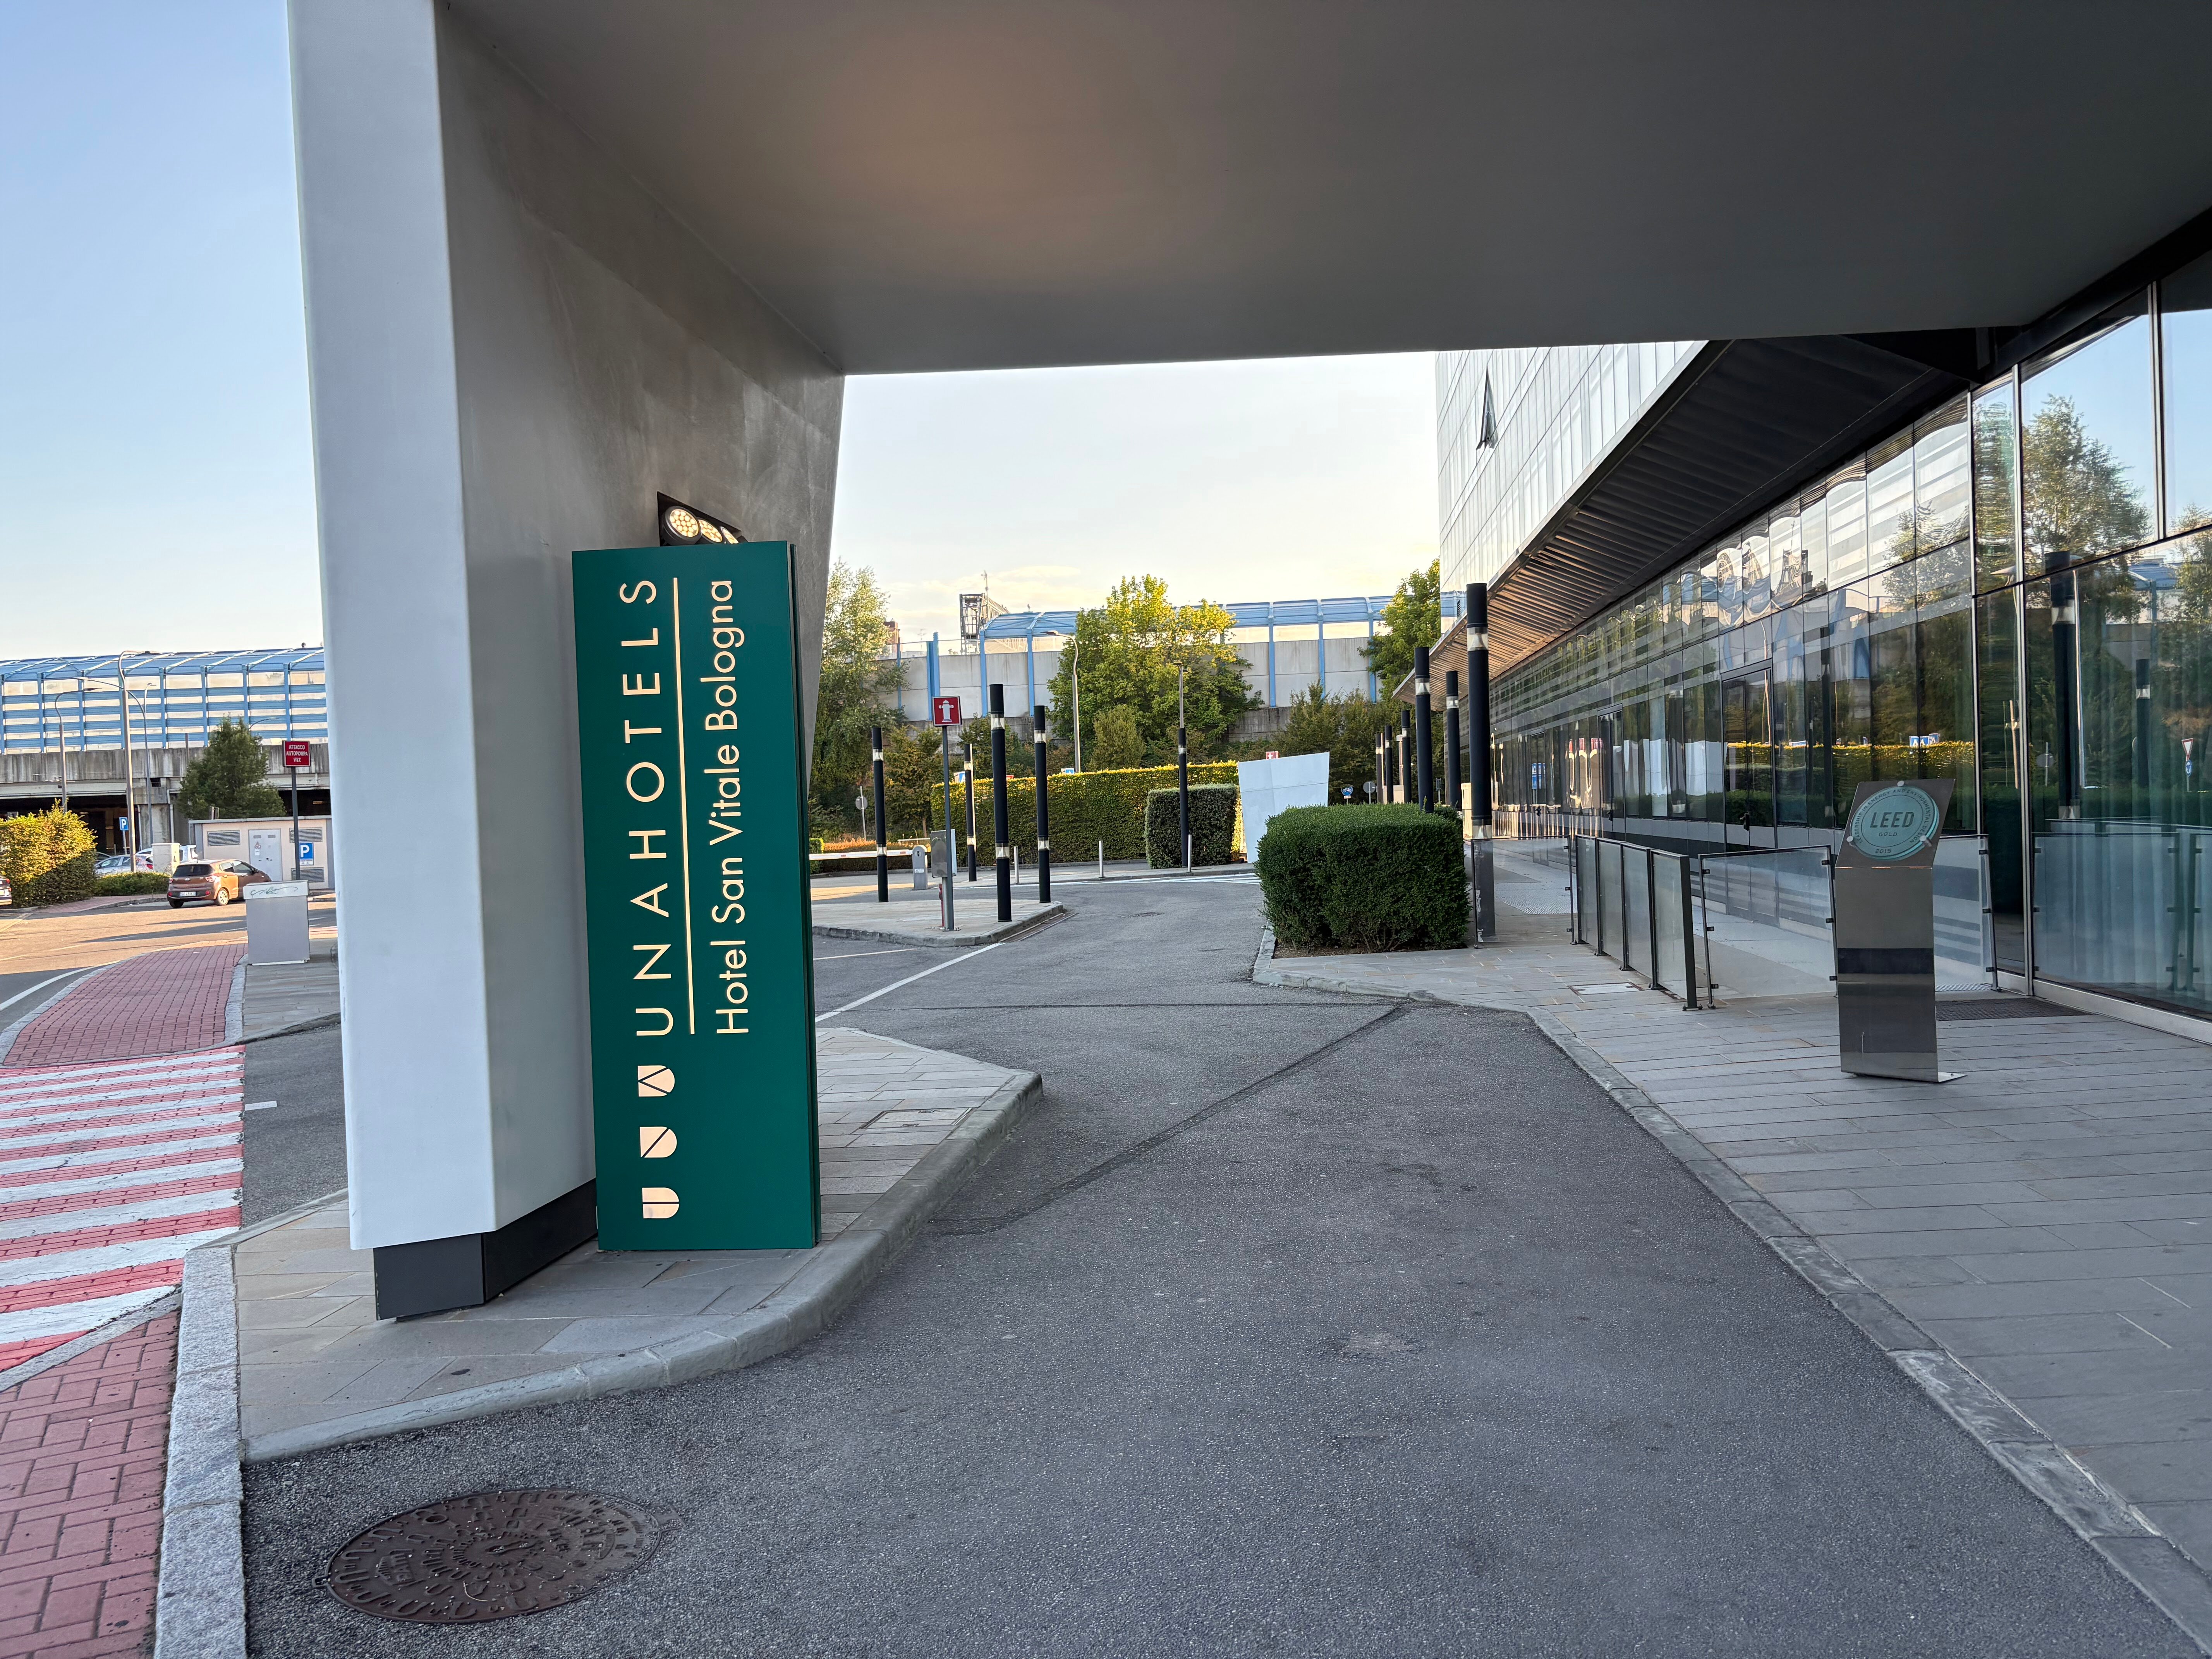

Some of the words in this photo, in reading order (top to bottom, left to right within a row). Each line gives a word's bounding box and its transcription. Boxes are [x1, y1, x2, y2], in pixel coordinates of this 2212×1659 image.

[700, 580, 745, 731] Bologna
[619, 580, 674, 1036] UNAHOTELS
[704, 744, 743, 846] Vitale
[1868, 791, 1890, 805] ENERGY
[1907, 790, 1931, 823] ENVIRONMENTAL
[121, 819, 127, 829] P
[1854, 812, 1863, 843] LEADERSHIP
[1870, 812, 1915, 828] LEED
[1910, 825, 1927, 843] DESIGN
[300, 844, 310, 858] P
[711, 857, 745, 924] San
[710, 940, 749, 1034] Hotel
